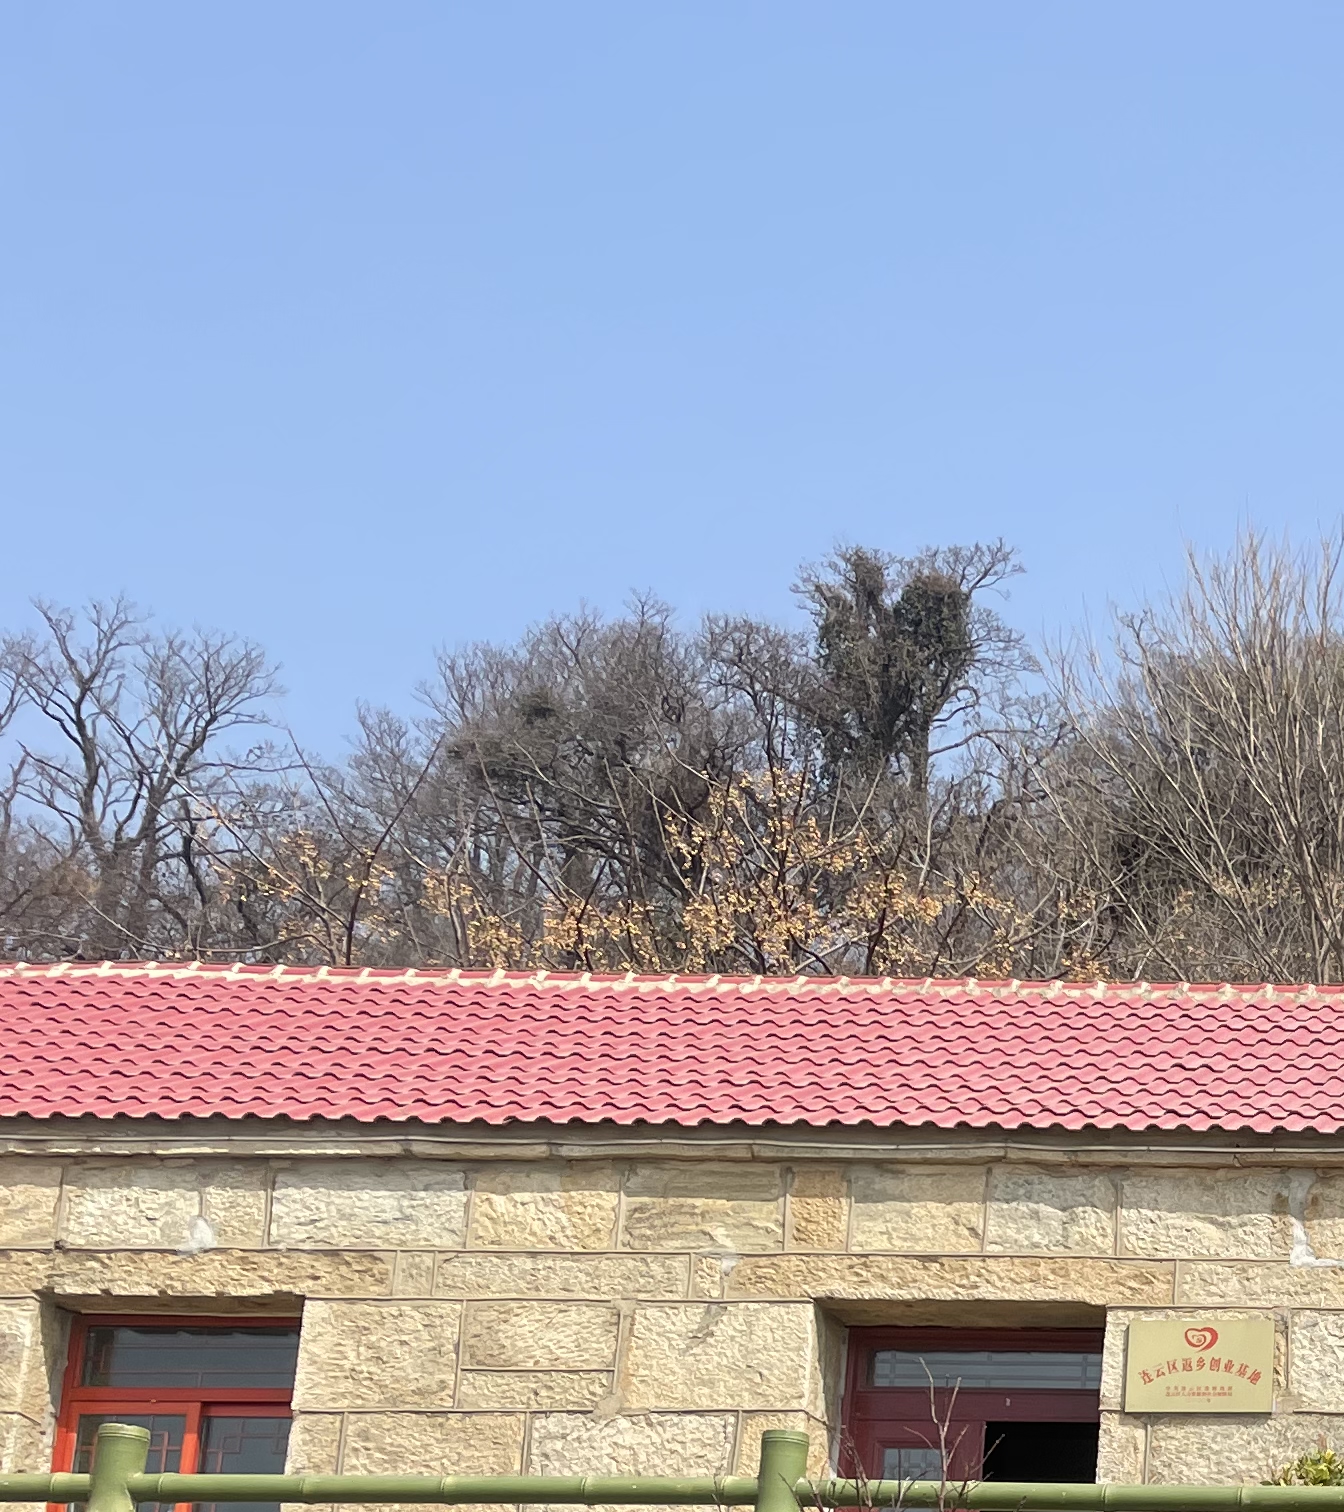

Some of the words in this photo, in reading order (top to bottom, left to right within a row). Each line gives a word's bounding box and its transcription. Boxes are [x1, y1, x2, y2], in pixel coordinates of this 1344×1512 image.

[1138, 1356, 1262, 1386] 连云区返乡创业基地
